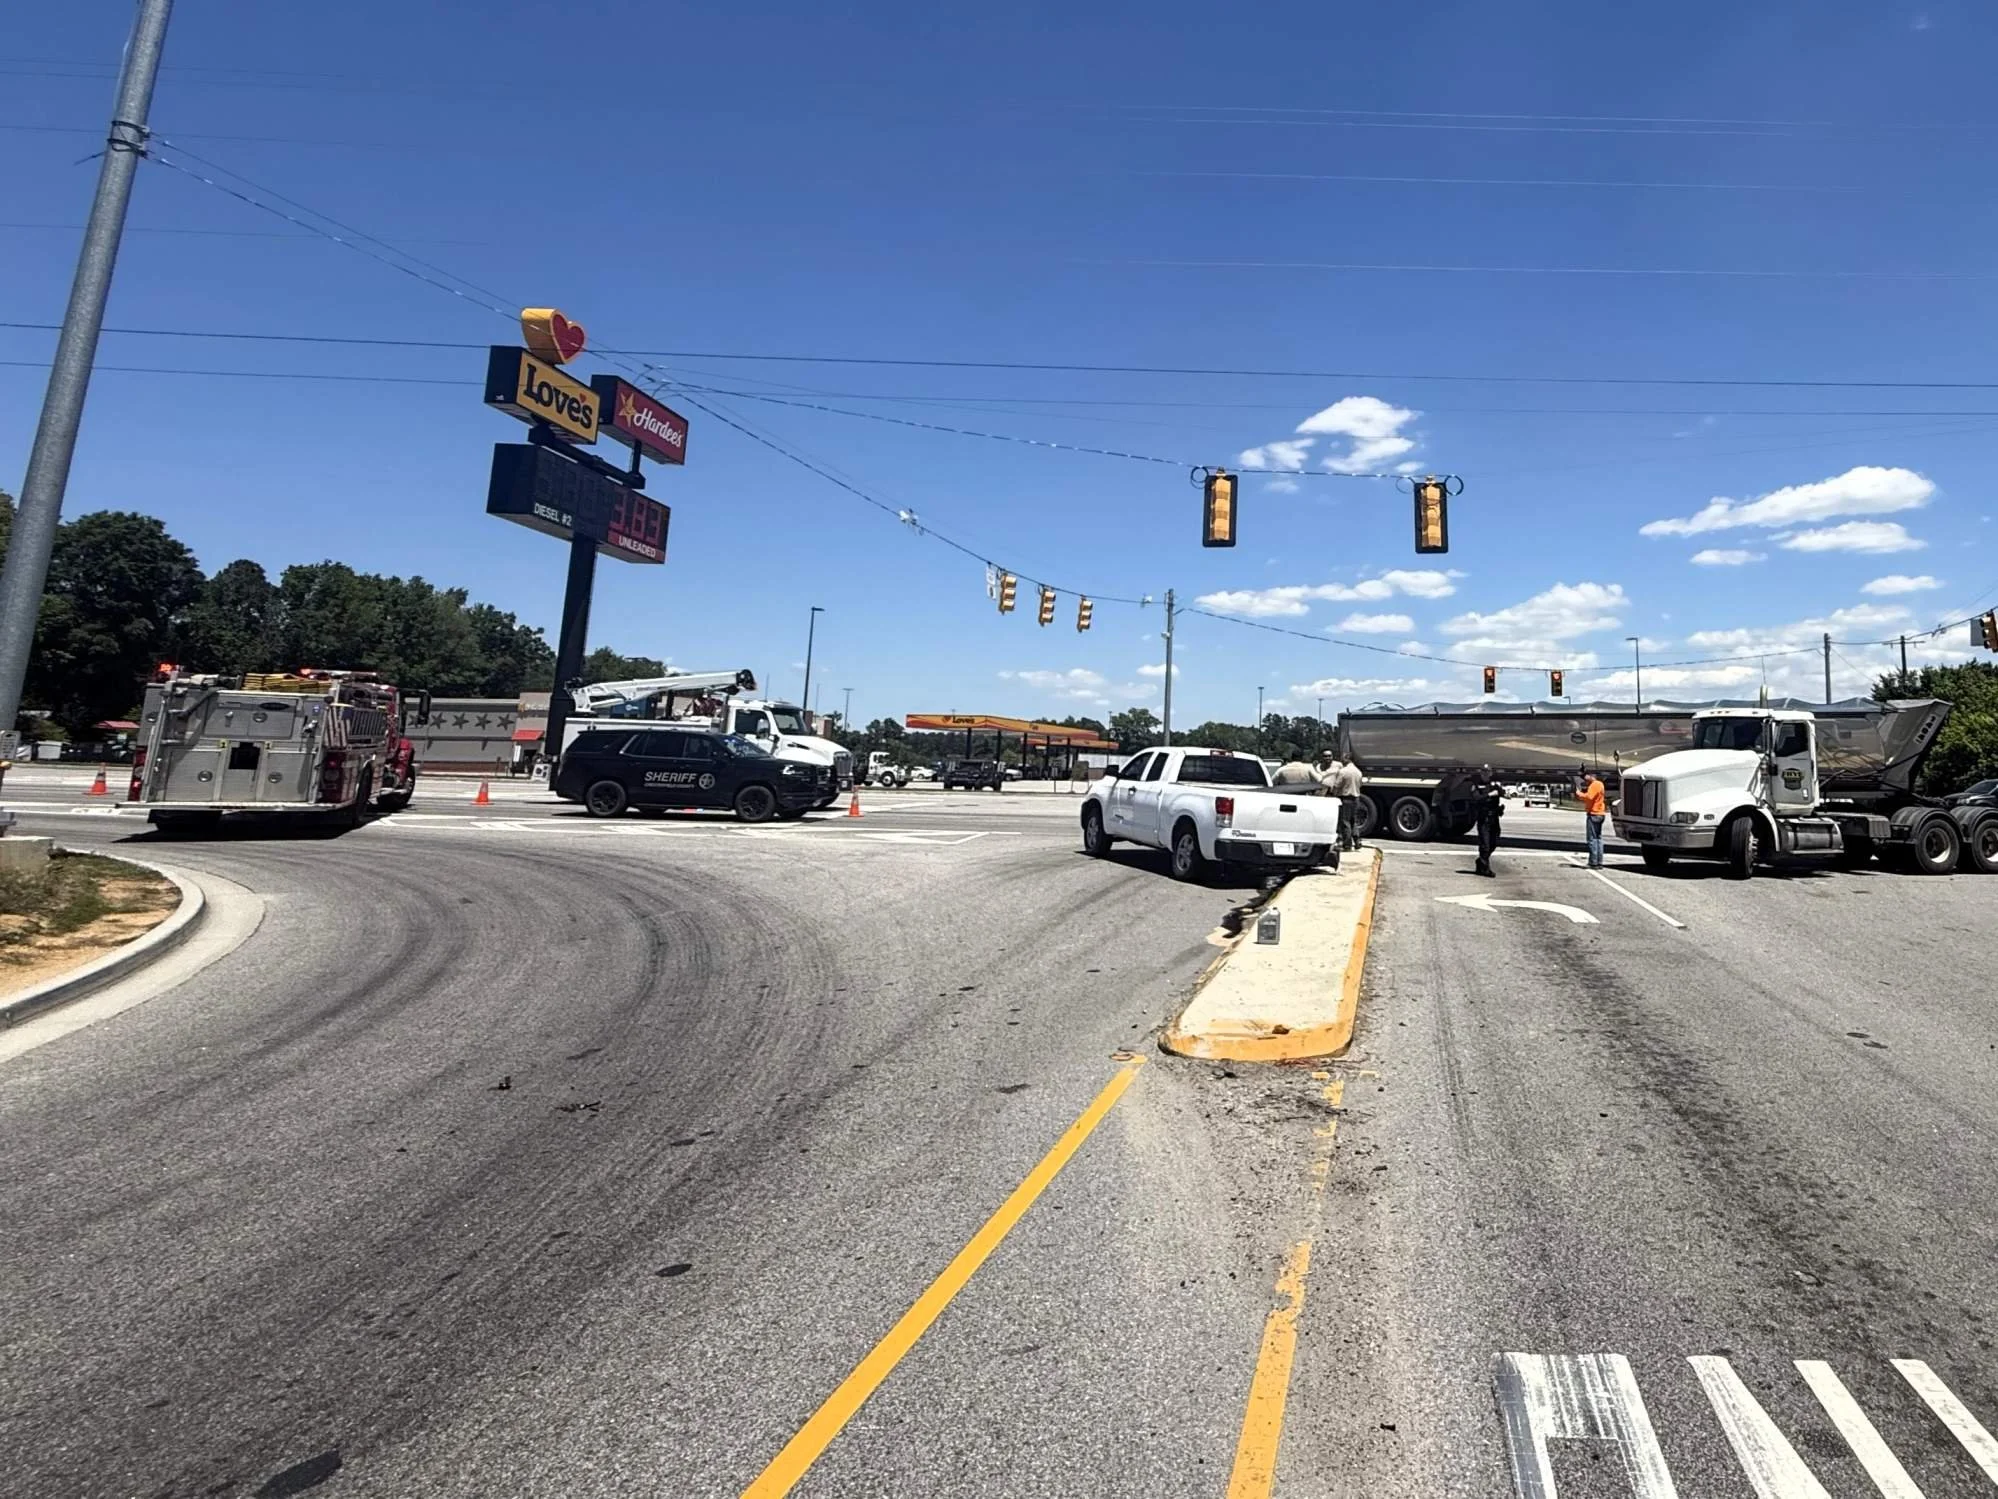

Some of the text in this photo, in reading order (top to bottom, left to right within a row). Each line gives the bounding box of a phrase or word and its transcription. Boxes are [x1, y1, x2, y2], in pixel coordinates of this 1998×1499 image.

[634, 408, 683, 447] Hardee's
[534, 502, 573, 527] DIESEL #2
[618, 535, 656, 558] UNLEADED
[644, 771, 697, 783] SHERIFF
